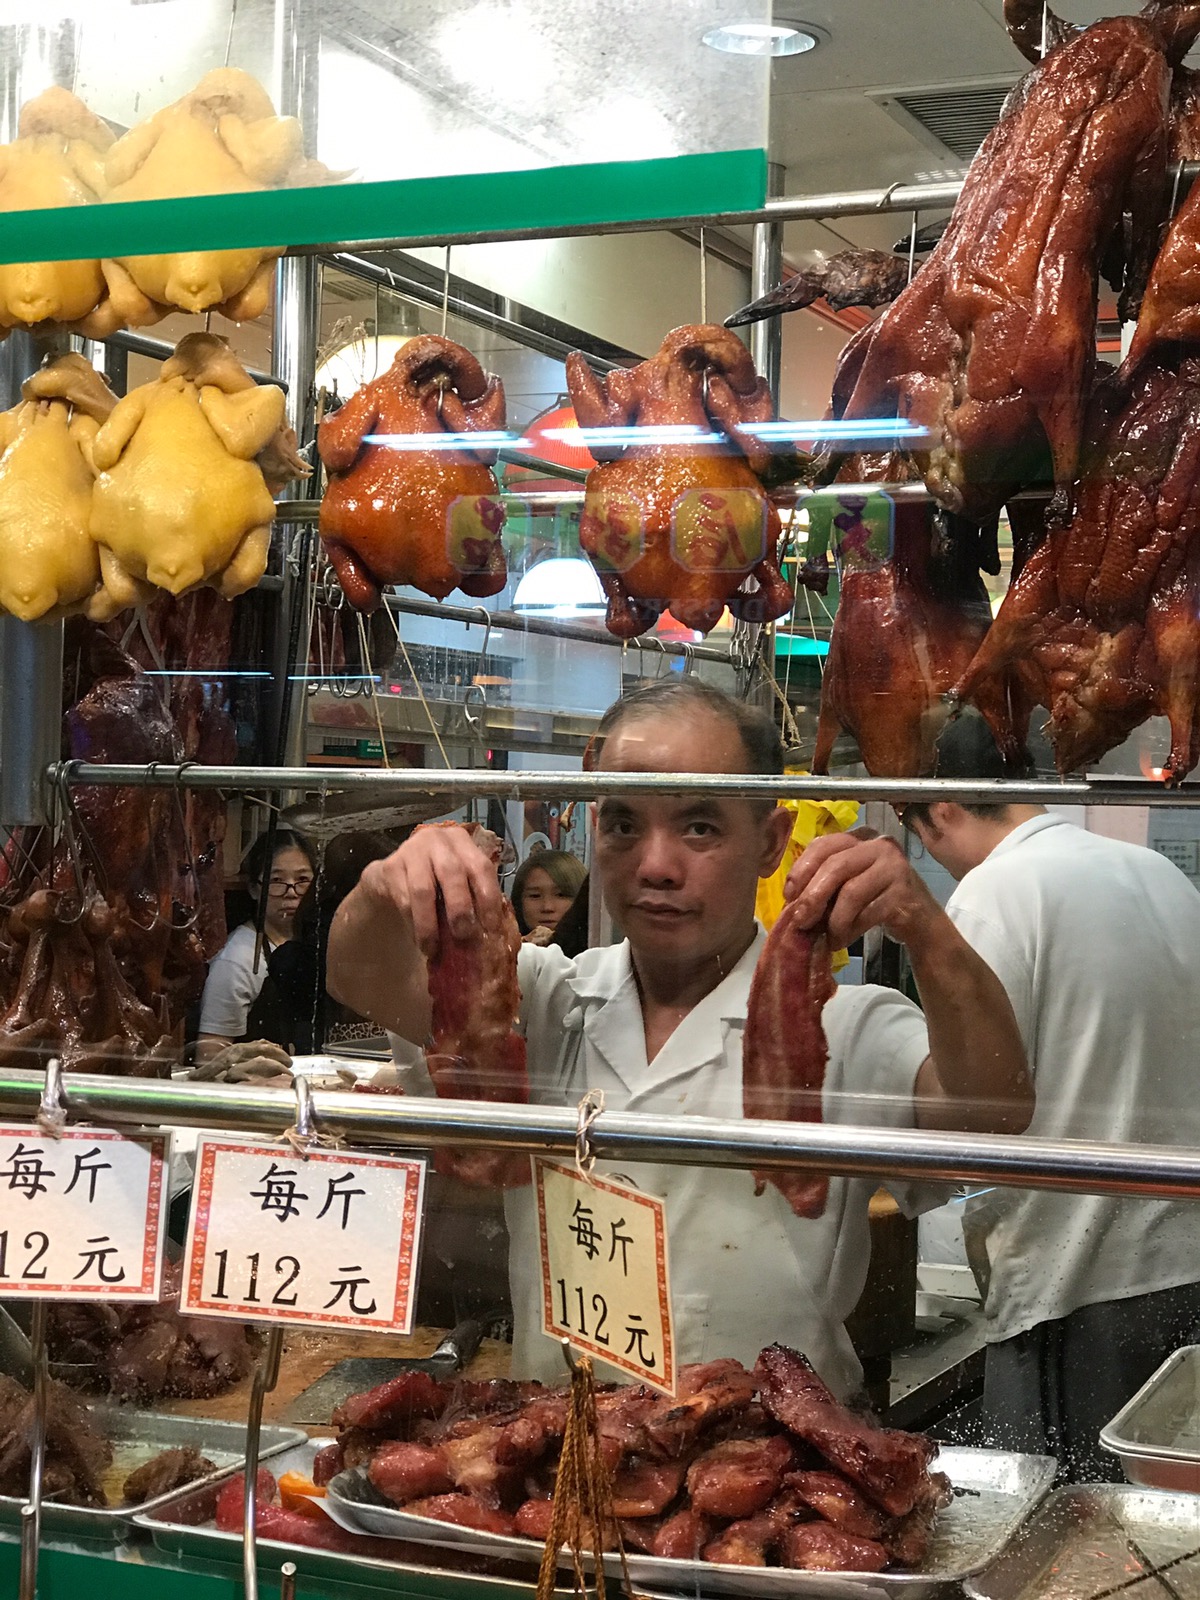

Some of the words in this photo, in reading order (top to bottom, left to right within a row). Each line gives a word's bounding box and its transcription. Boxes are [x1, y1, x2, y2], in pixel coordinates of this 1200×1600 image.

[0, 1142, 113, 1204] 每斤
[249, 1162, 367, 1231] 每斤
[72, 1235, 126, 1283] 元
[567, 1199, 635, 1278] 每斤
[210, 1248, 301, 1307] 112
[322, 1264, 378, 1316] 元
[556, 1278, 610, 1346] 112
[624, 1314, 656, 1368] 元
